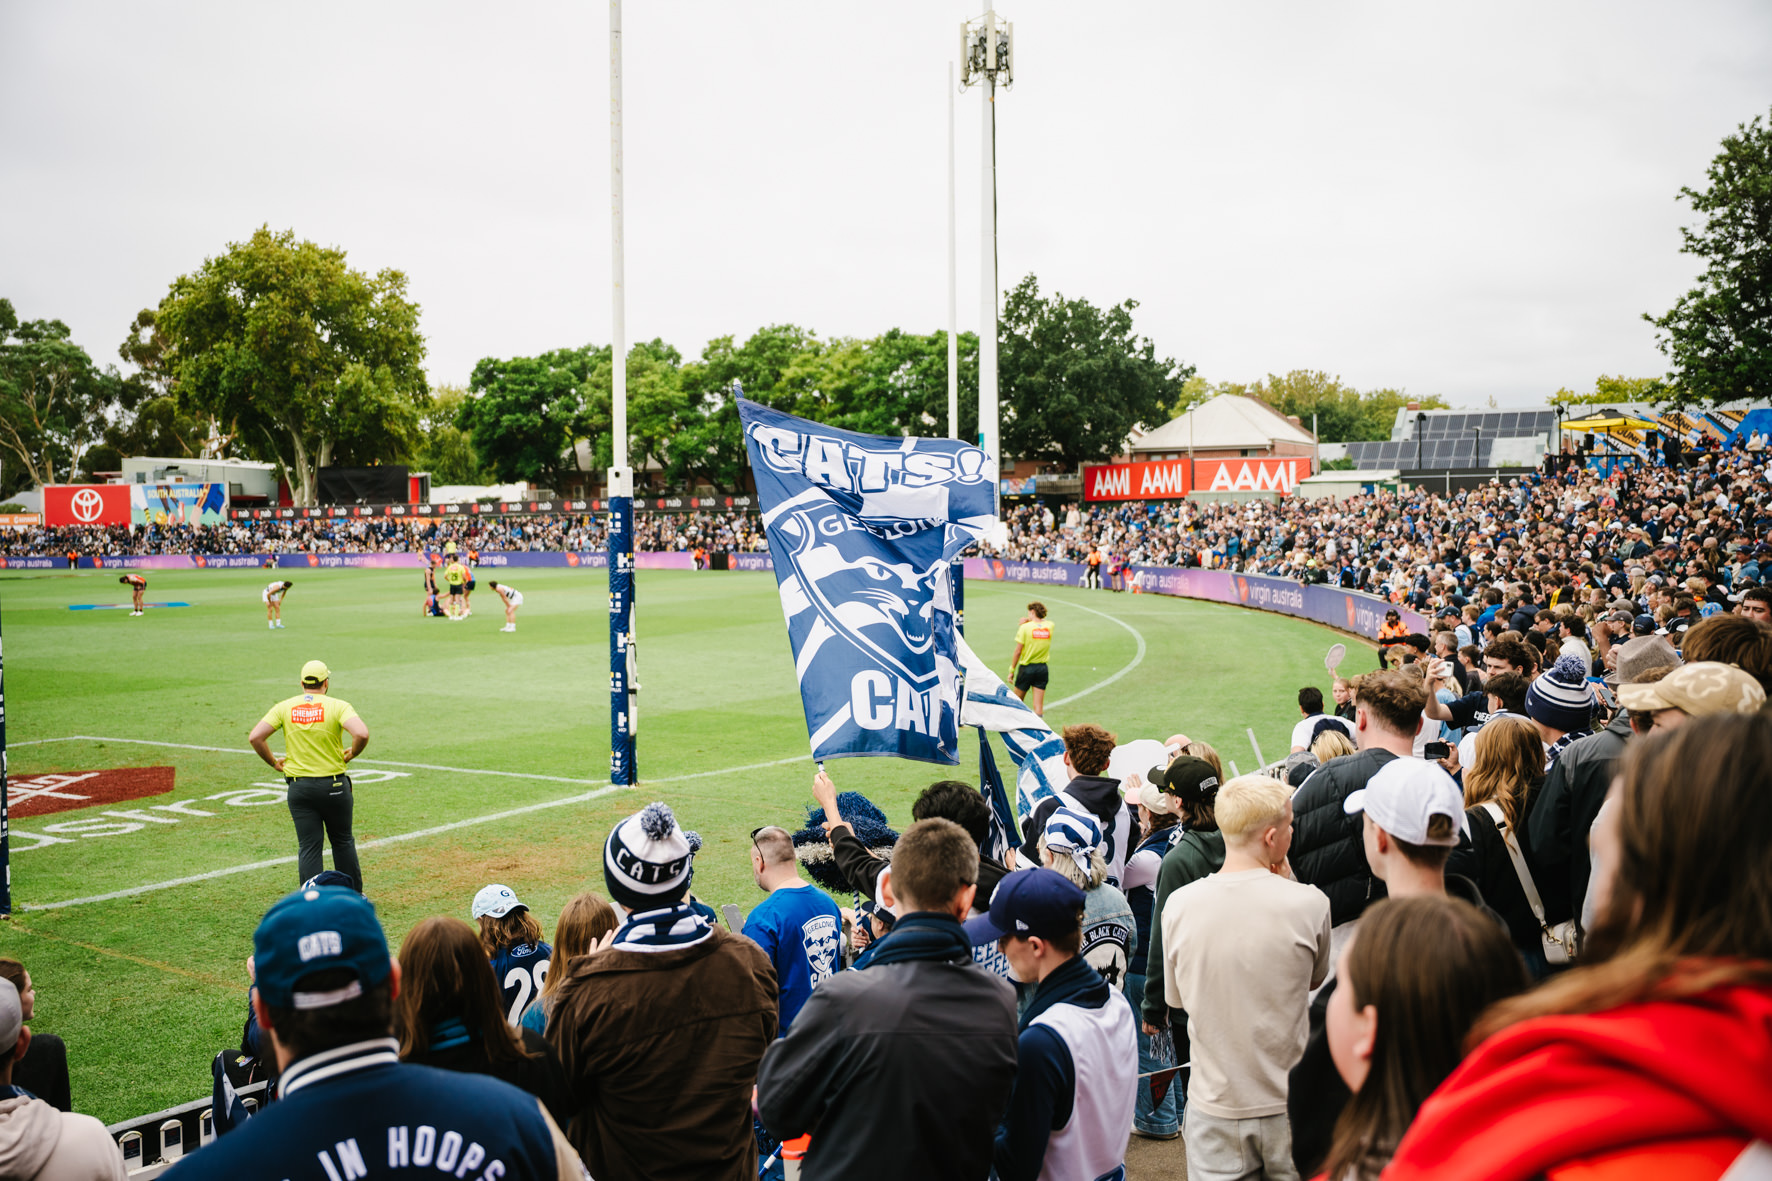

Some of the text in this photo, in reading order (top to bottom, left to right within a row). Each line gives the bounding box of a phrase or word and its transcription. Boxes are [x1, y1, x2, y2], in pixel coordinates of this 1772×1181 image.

[1711, 411, 1739, 432] ATHER
[747, 421, 987, 495] CATS!
[1093, 463, 1182, 497] AAMI AAMI
[1210, 461, 1297, 493] AAMI
[147, 488, 203, 499] SOUTH AUSTRALIA
[666, 498, 682, 507] nab
[700, 497, 716, 506] nab
[734, 496, 750, 505] nab
[238, 500, 586, 518] nab nab nab nab nab nab nab nab nab nab nab nab nab
[818, 513, 944, 540] GELON
[8, 560, 53, 569] virgin australia
[104, 559, 123, 569] virgin
[206, 557, 259, 568] virgin australia
[320, 556, 343, 567] virgin
[478, 555, 507, 565] ustralia
[581, 555, 606, 567] virgin
[739, 556, 764, 569] virgin
[1006, 563, 1067, 580] virgin australia
[1250, 585, 1303, 609] virgin australia
[1356, 604, 1374, 628] virgin
[292, 708, 323, 718] CHEMIST
[616, 847, 681, 883] CATS
[500, 889, 510, 898] G
[807, 920, 834, 935] GEELONG
[1089, 925, 1110, 942] BLACK
[298, 930, 342, 962] CATS
[317, 1125, 506, 1181] IN HOOPS
